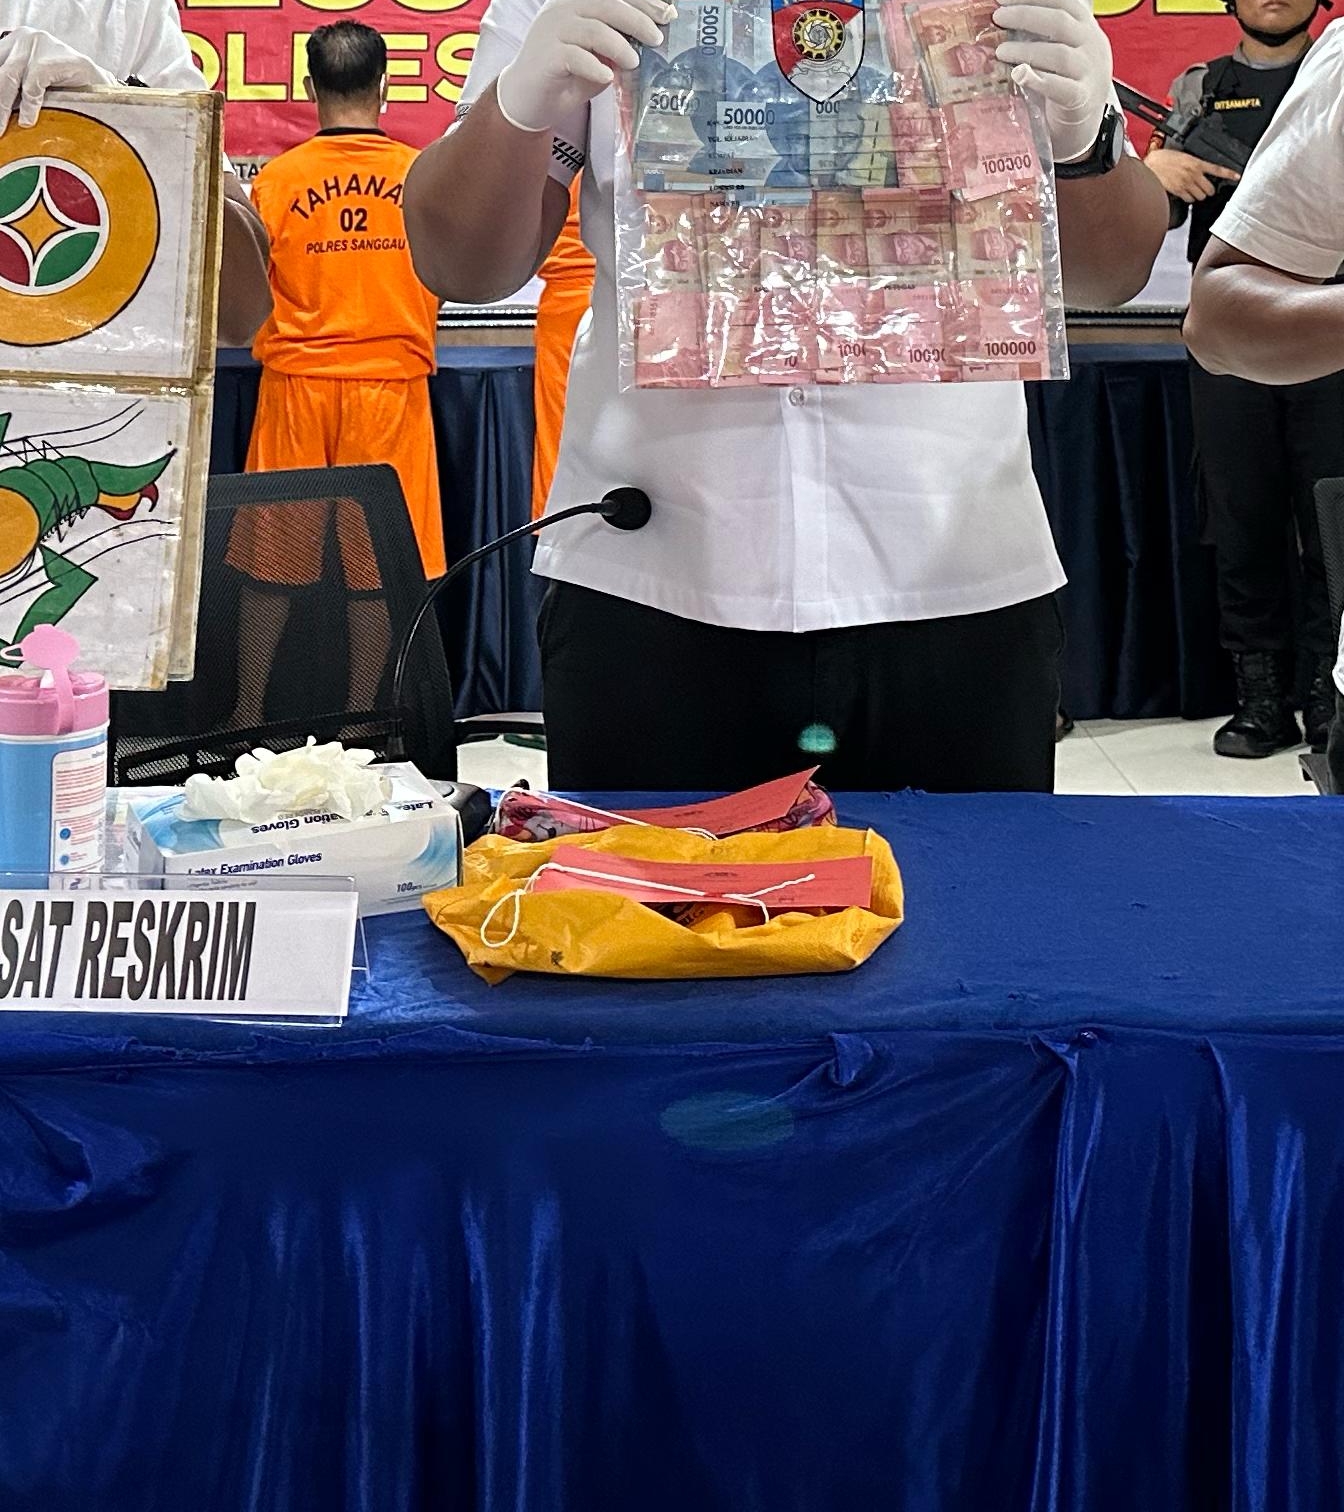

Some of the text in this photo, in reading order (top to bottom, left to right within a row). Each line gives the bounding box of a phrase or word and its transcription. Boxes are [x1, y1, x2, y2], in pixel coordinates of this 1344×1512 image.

[701, 5, 719, 56] 50000
[182, 31, 480, 103] LES
[723, 107, 776, 126] 50000
[982, 155, 1032, 175] 100000
[290, 173, 404, 220] TAHANA
[340, 207, 368, 233] 02
[306, 237, 406, 255] POLRES SANGGAU
[985, 340, 1037, 357] 100000
[251, 819, 301, 834] Gloves
[220, 859, 284, 875] Examination
[287, 852, 323, 866] Gloves
[77, 901, 256, 1003] RESKRIM
